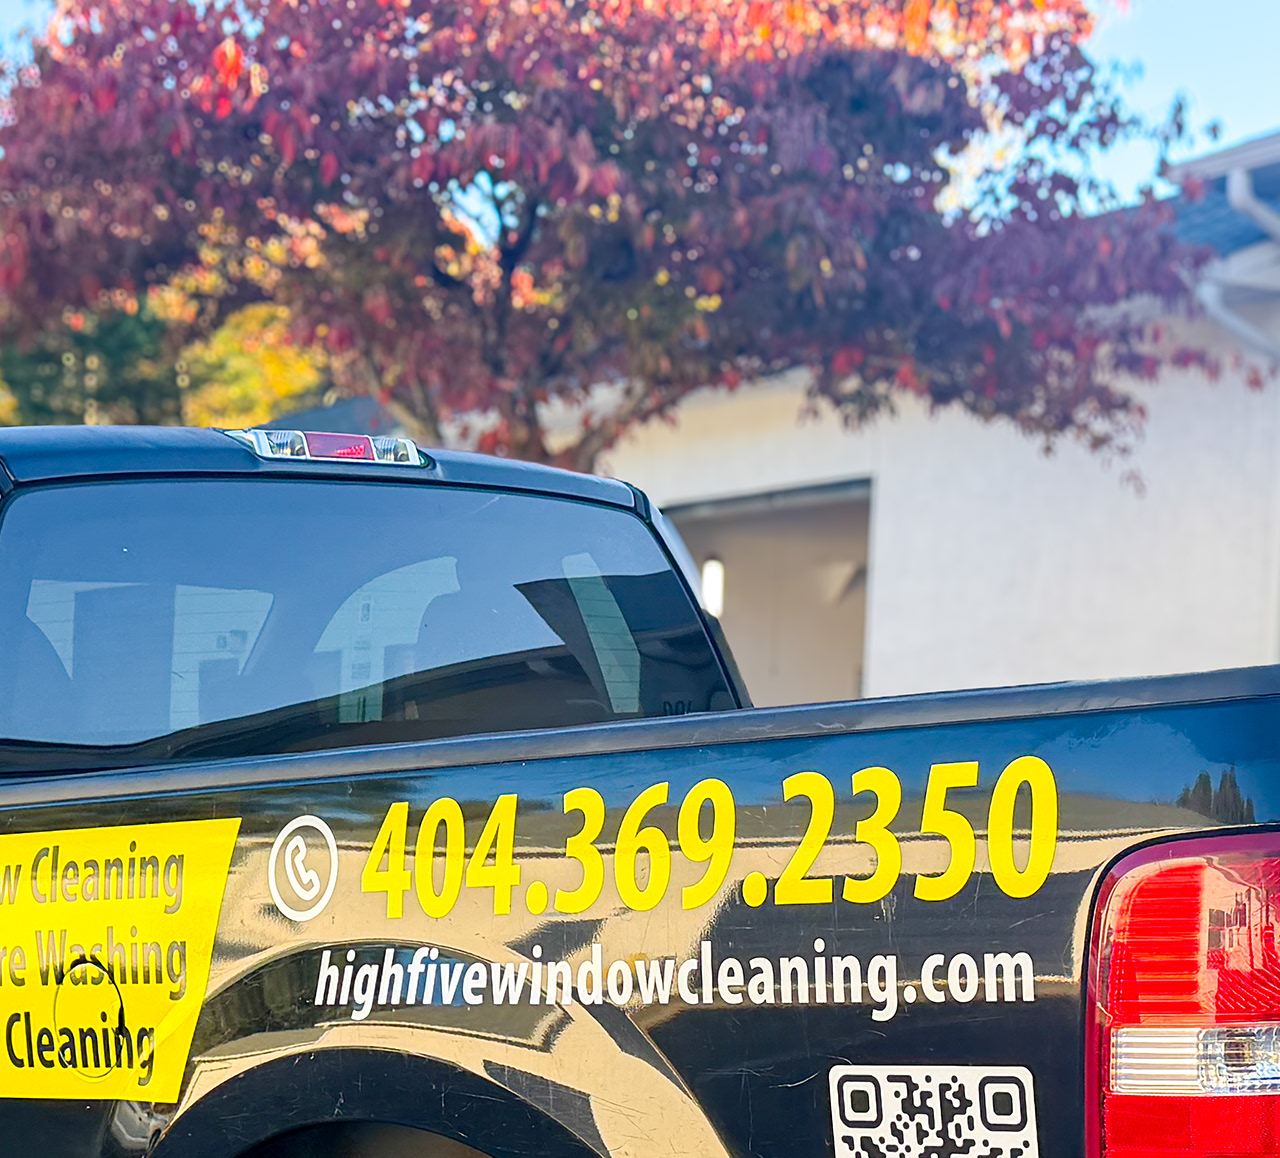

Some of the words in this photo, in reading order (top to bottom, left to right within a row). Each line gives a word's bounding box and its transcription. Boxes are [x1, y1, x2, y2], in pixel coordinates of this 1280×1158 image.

[360, 755, 1059, 920] 404.369.2350
[31, 840, 185, 914] Cleaning
[35, 925, 187, 1000] Washing
[314, 938, 1036, 1022] highfivewindowcleaning.com
[6, 1010, 155, 1086] Cleaning
